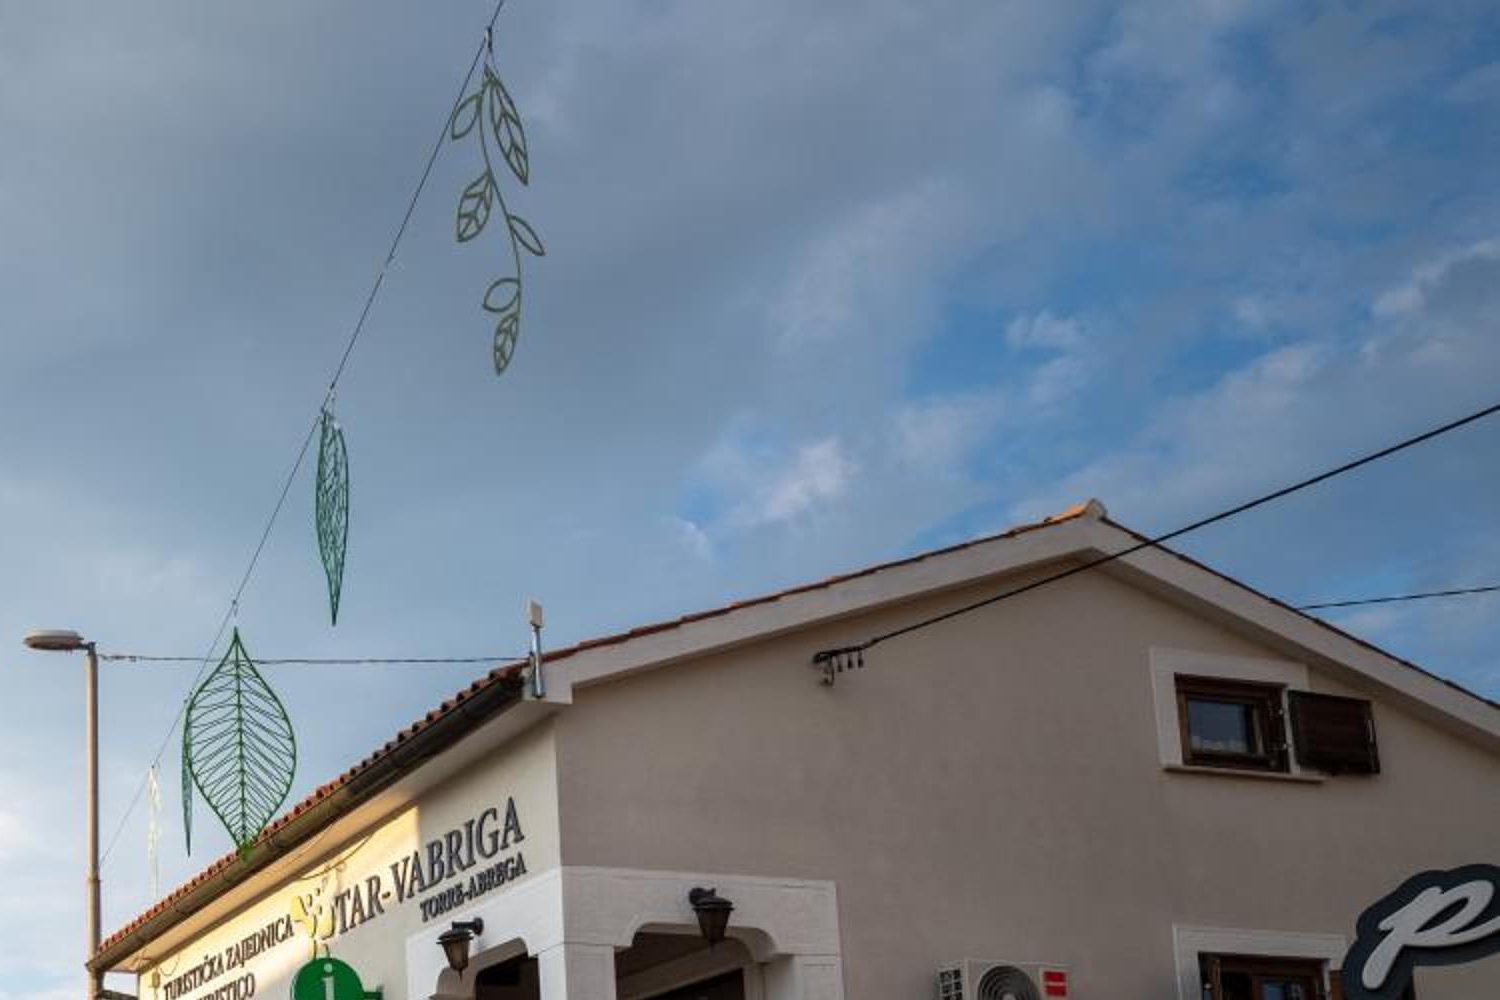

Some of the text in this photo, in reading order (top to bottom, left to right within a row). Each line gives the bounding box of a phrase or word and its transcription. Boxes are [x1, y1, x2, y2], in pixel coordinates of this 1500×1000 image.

[335, 796, 524, 934] TAR-VABRIGA
[420, 852, 528, 923] TORRE-ABREGA
[226, 914, 295, 971] ZAJEDNICA
